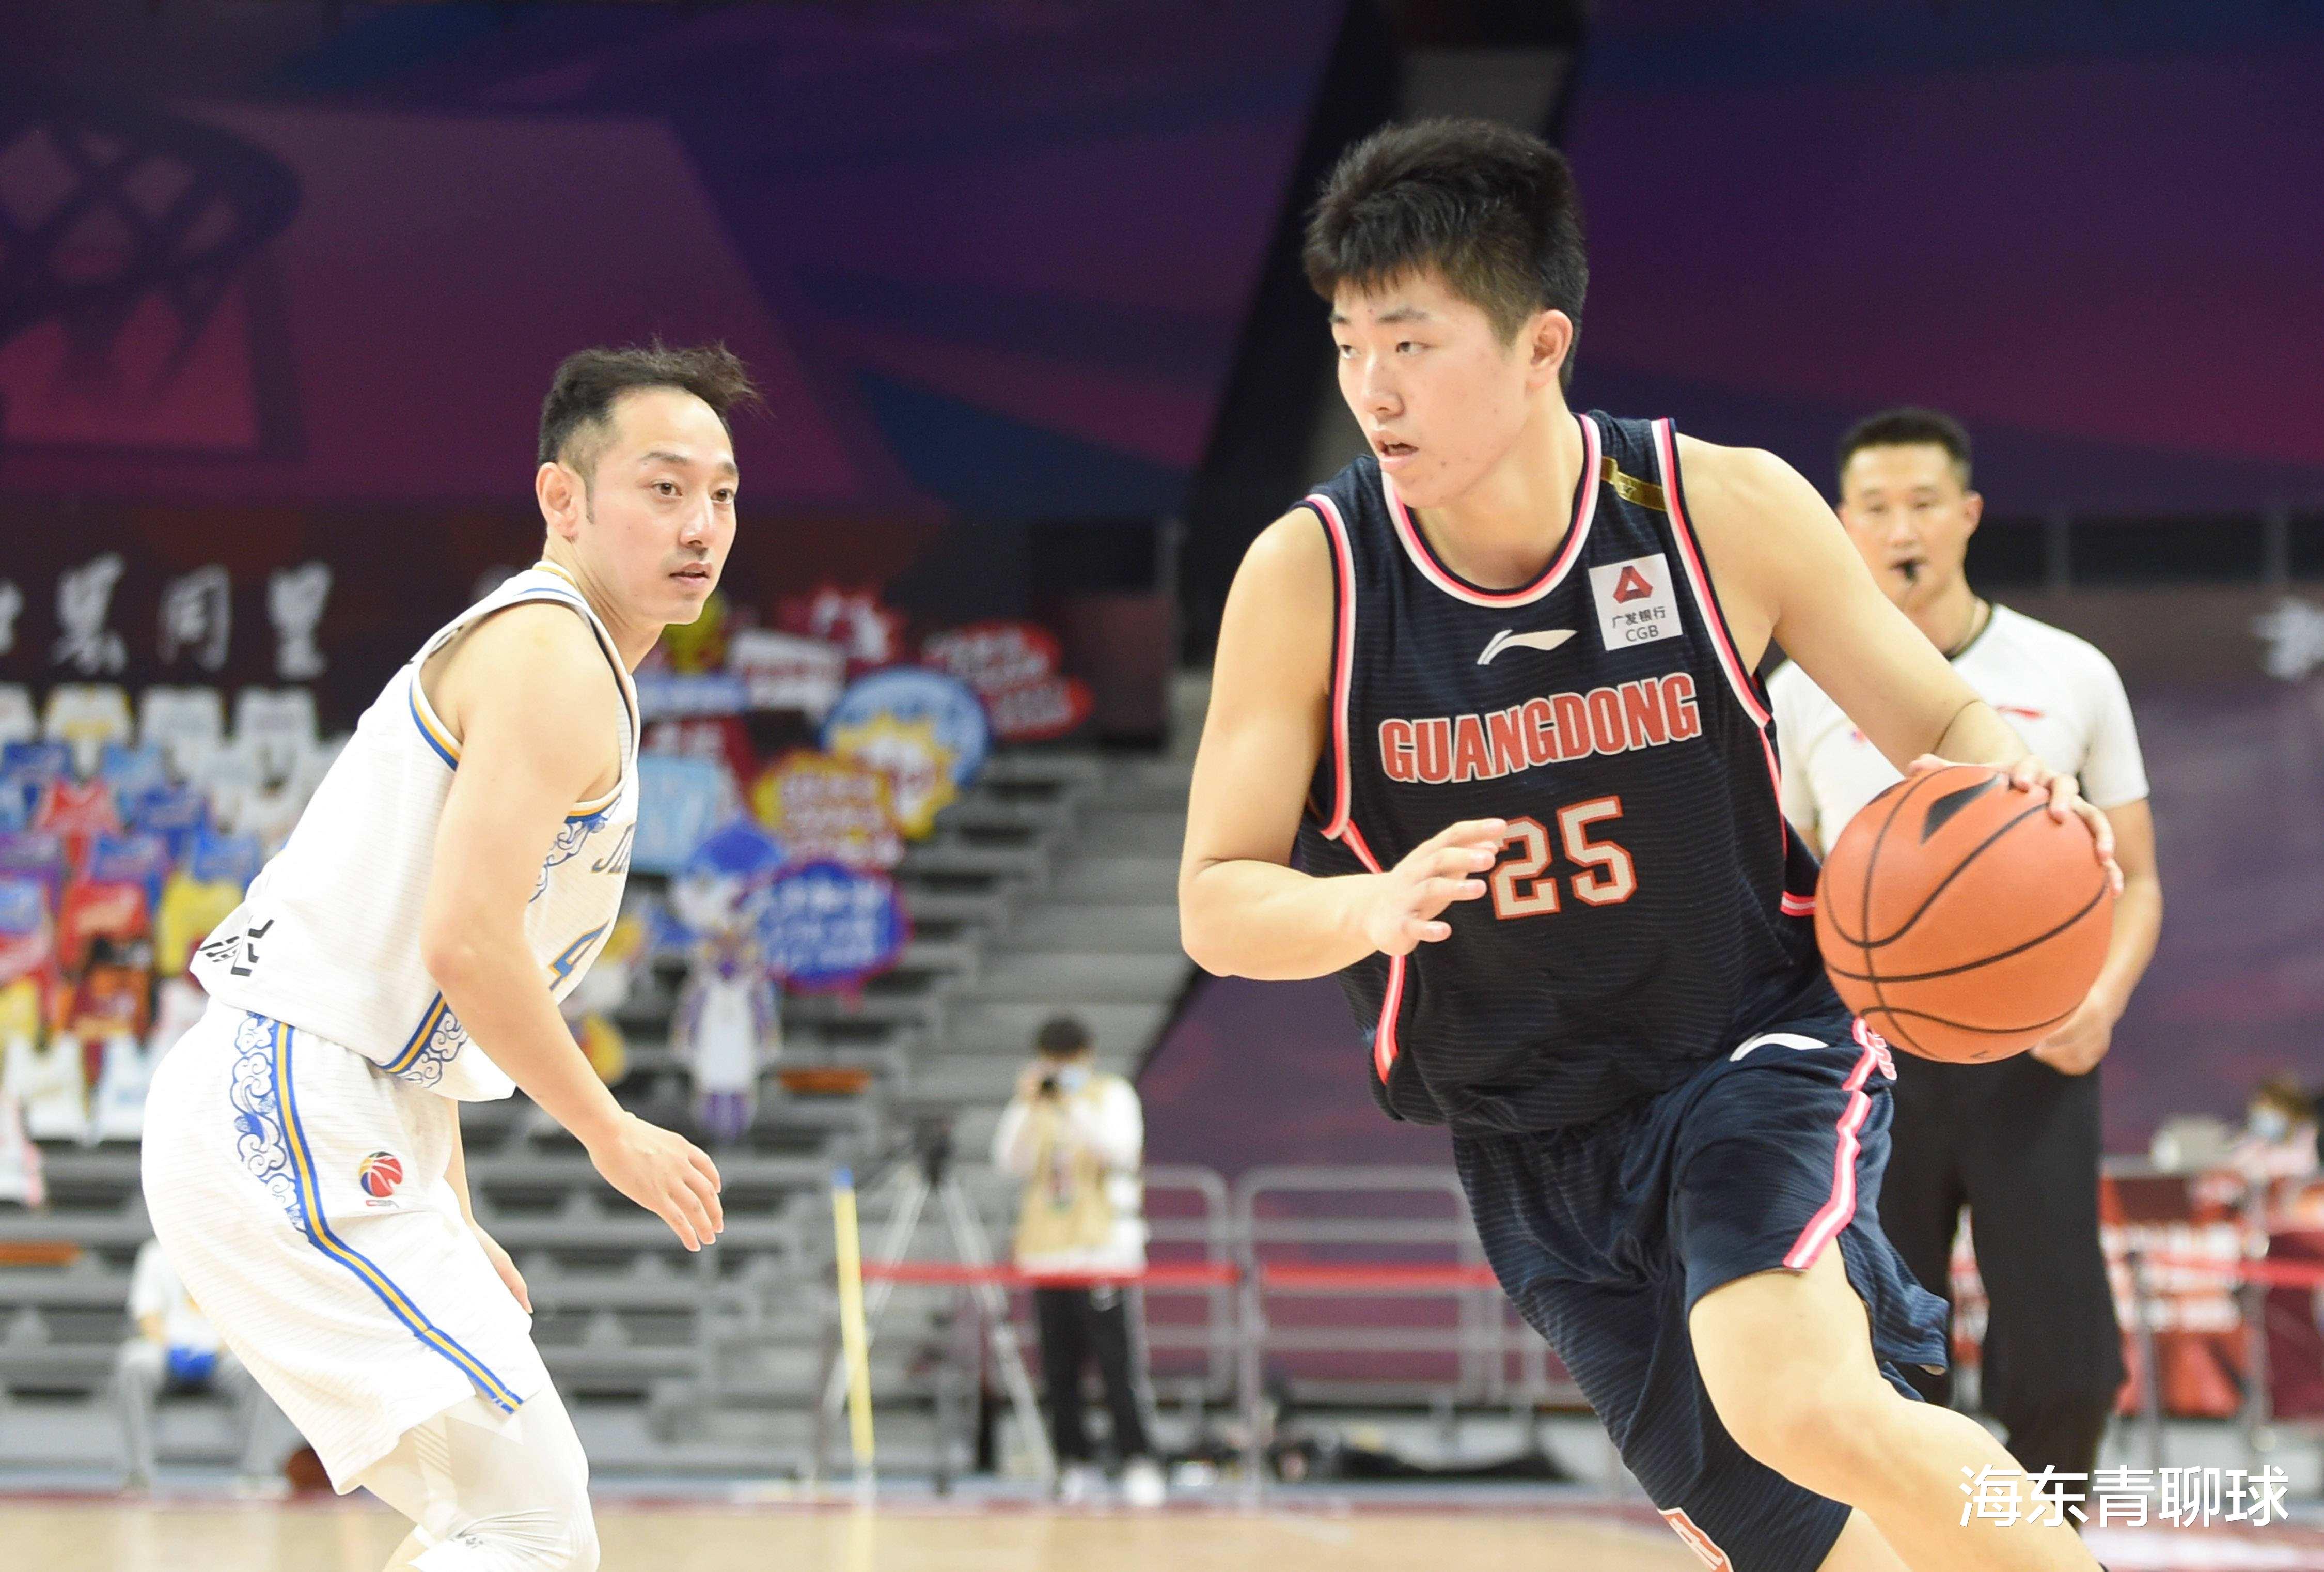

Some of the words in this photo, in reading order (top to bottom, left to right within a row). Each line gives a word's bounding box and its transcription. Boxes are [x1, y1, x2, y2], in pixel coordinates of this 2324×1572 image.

[1612, 606, 1666, 629] 广发银行
[1626, 625, 1659, 642] CGB
[1378, 672, 1702, 784] GUANGDONG
[1489, 795, 1638, 920] 25
